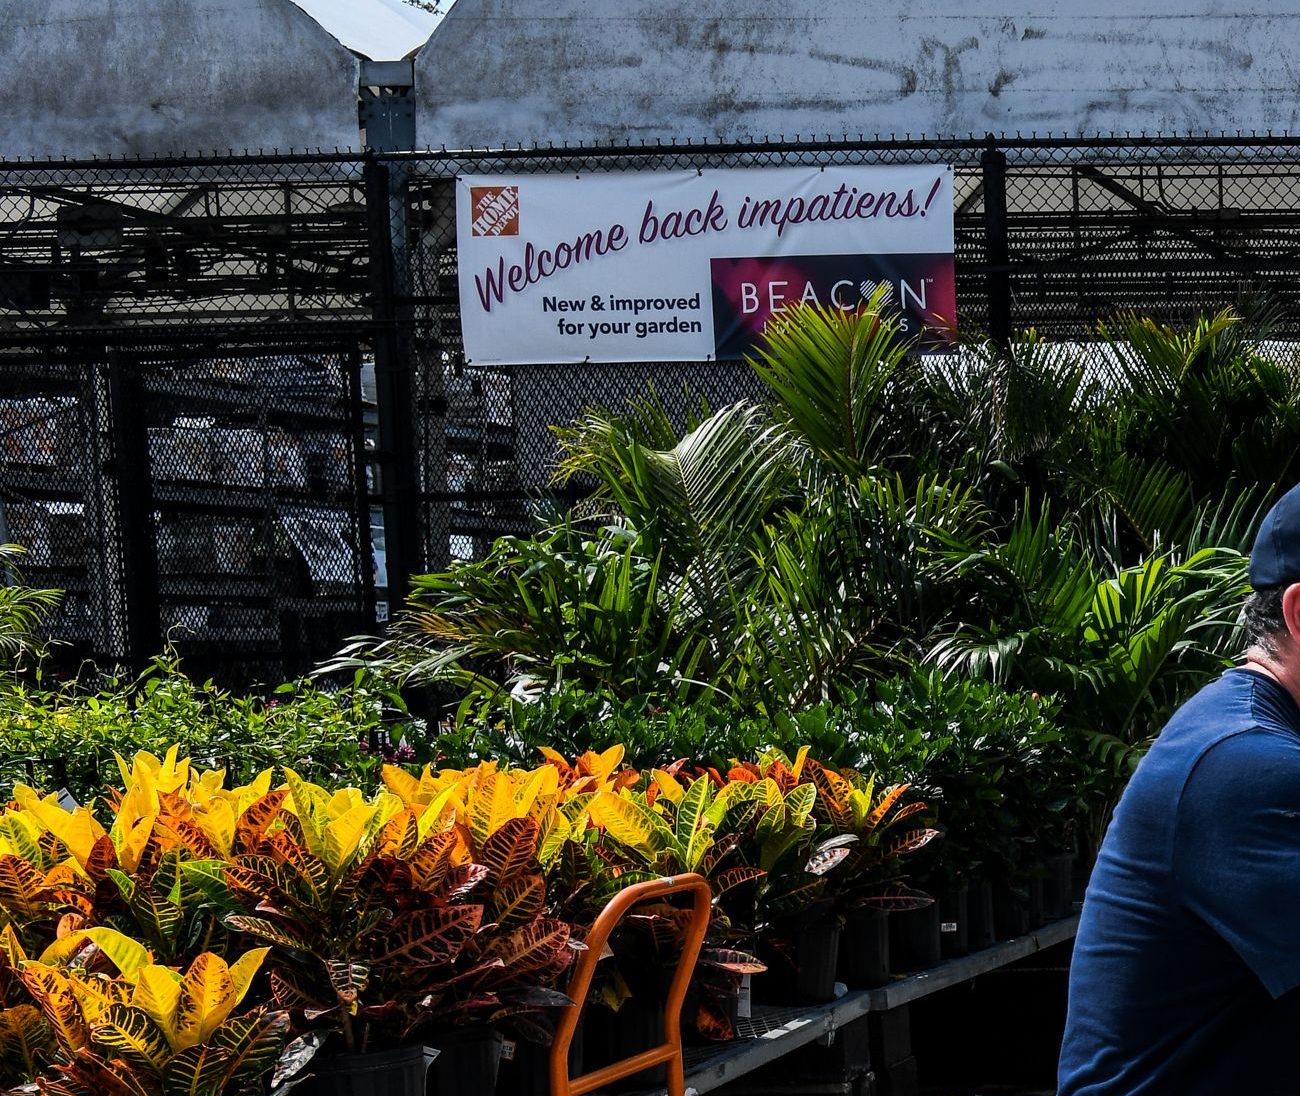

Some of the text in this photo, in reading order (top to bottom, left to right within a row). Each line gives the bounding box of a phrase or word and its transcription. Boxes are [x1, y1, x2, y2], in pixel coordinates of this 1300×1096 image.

[472, 186, 518, 236] HOME
[476, 191, 496, 212] THE
[491, 203, 519, 236] DEPOT
[474, 178, 942, 313] Welcome back impatiens!
[543, 293, 701, 316] New & improved
[557, 317, 703, 339] for your garden
